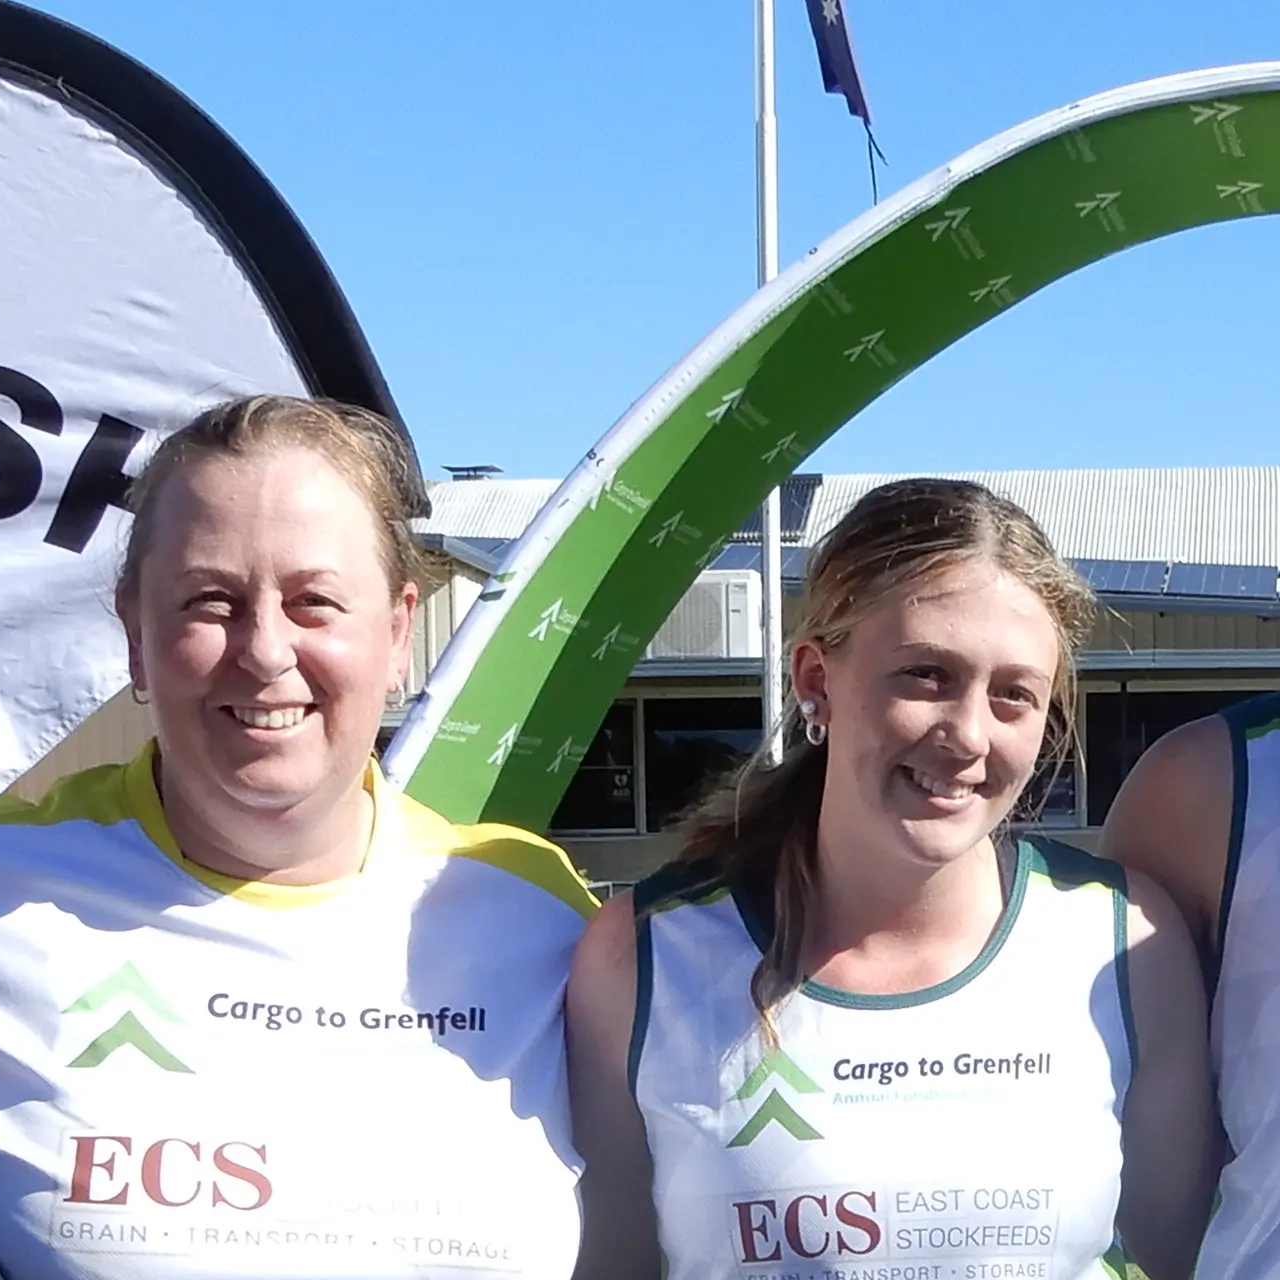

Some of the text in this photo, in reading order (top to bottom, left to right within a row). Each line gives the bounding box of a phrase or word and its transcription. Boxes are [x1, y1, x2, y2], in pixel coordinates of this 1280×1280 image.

[207, 992, 487, 1036] Cargo to Grenfell
[833, 1052, 1051, 1086] Cargo to Grenfell
[62, 1134, 273, 1212] ECS
[895, 1187, 1054, 1214] EAST COAST
[58, 1220, 148, 1243] GRAIN
[731, 1190, 882, 1264] ECS
[895, 1225, 1052, 1251] STOCKFEEDS
[965, 1261, 1047, 1280] STORAGE
